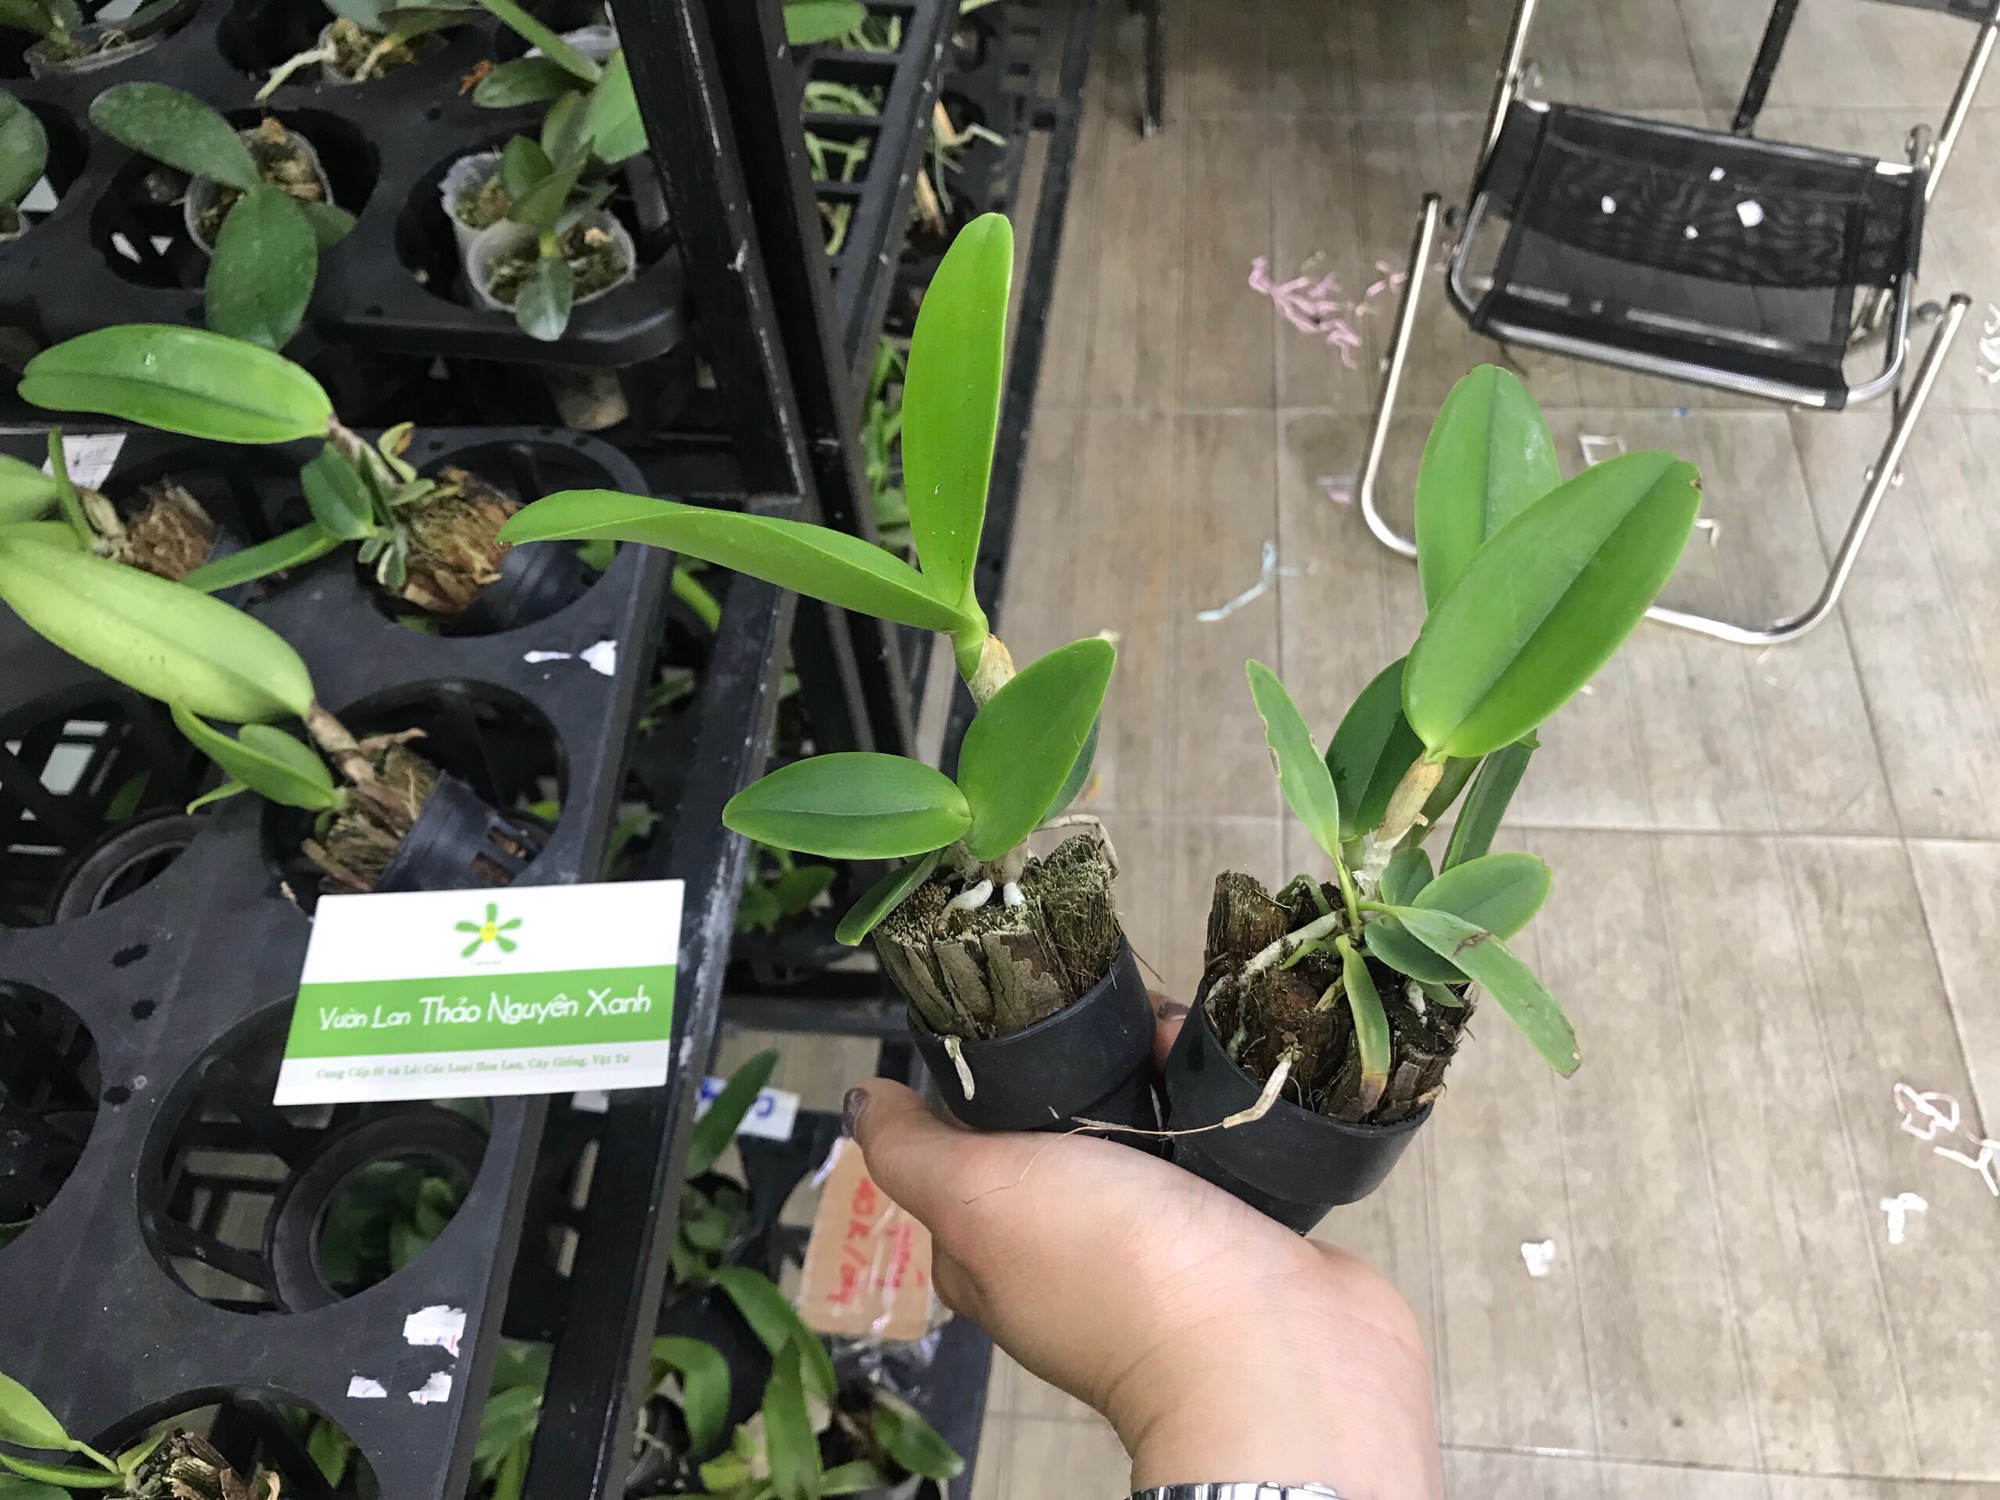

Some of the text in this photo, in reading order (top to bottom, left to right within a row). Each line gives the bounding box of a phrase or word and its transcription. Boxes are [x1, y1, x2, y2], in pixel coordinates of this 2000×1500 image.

[371, 1004, 411, 1028] Lan
[419, 996, 481, 1026] Thảo
[487, 991, 578, 1024] Nguyên
[585, 985, 651, 1018] Xanh
